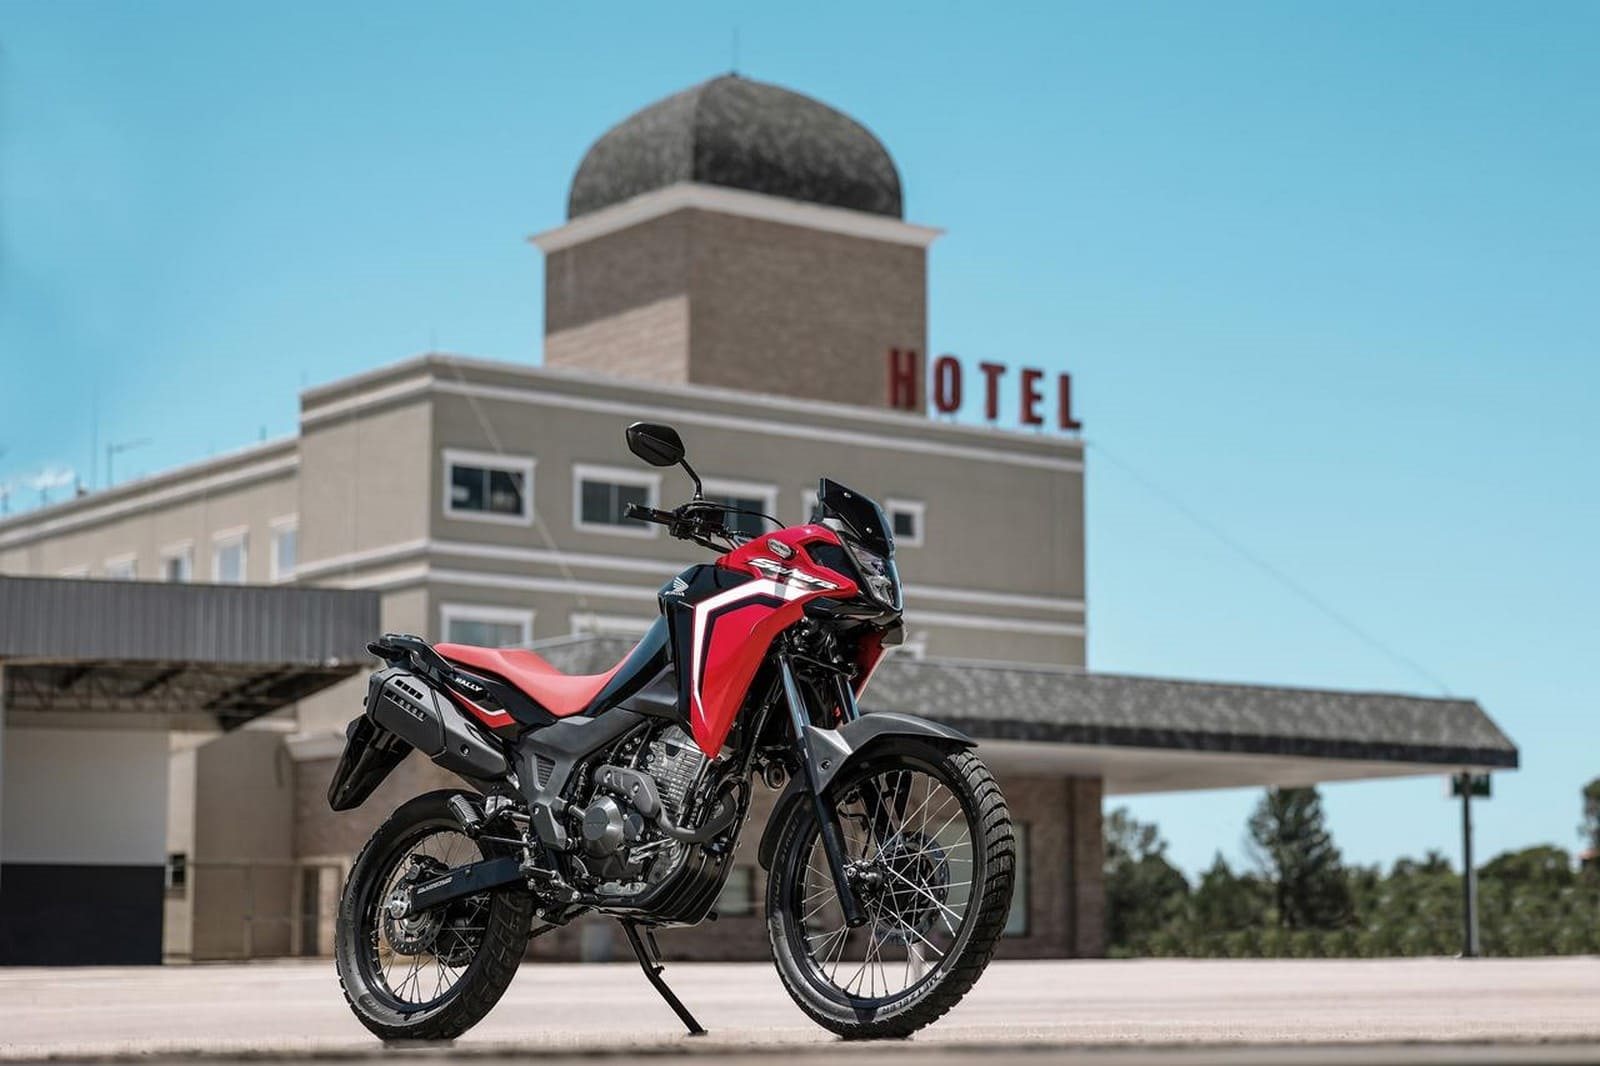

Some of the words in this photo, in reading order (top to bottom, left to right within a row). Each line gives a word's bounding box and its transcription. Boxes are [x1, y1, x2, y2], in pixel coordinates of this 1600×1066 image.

[887, 346, 1082, 430] HOTEL
[455, 677, 484, 692] RALLY
[882, 975, 941, 1016] METZELER
